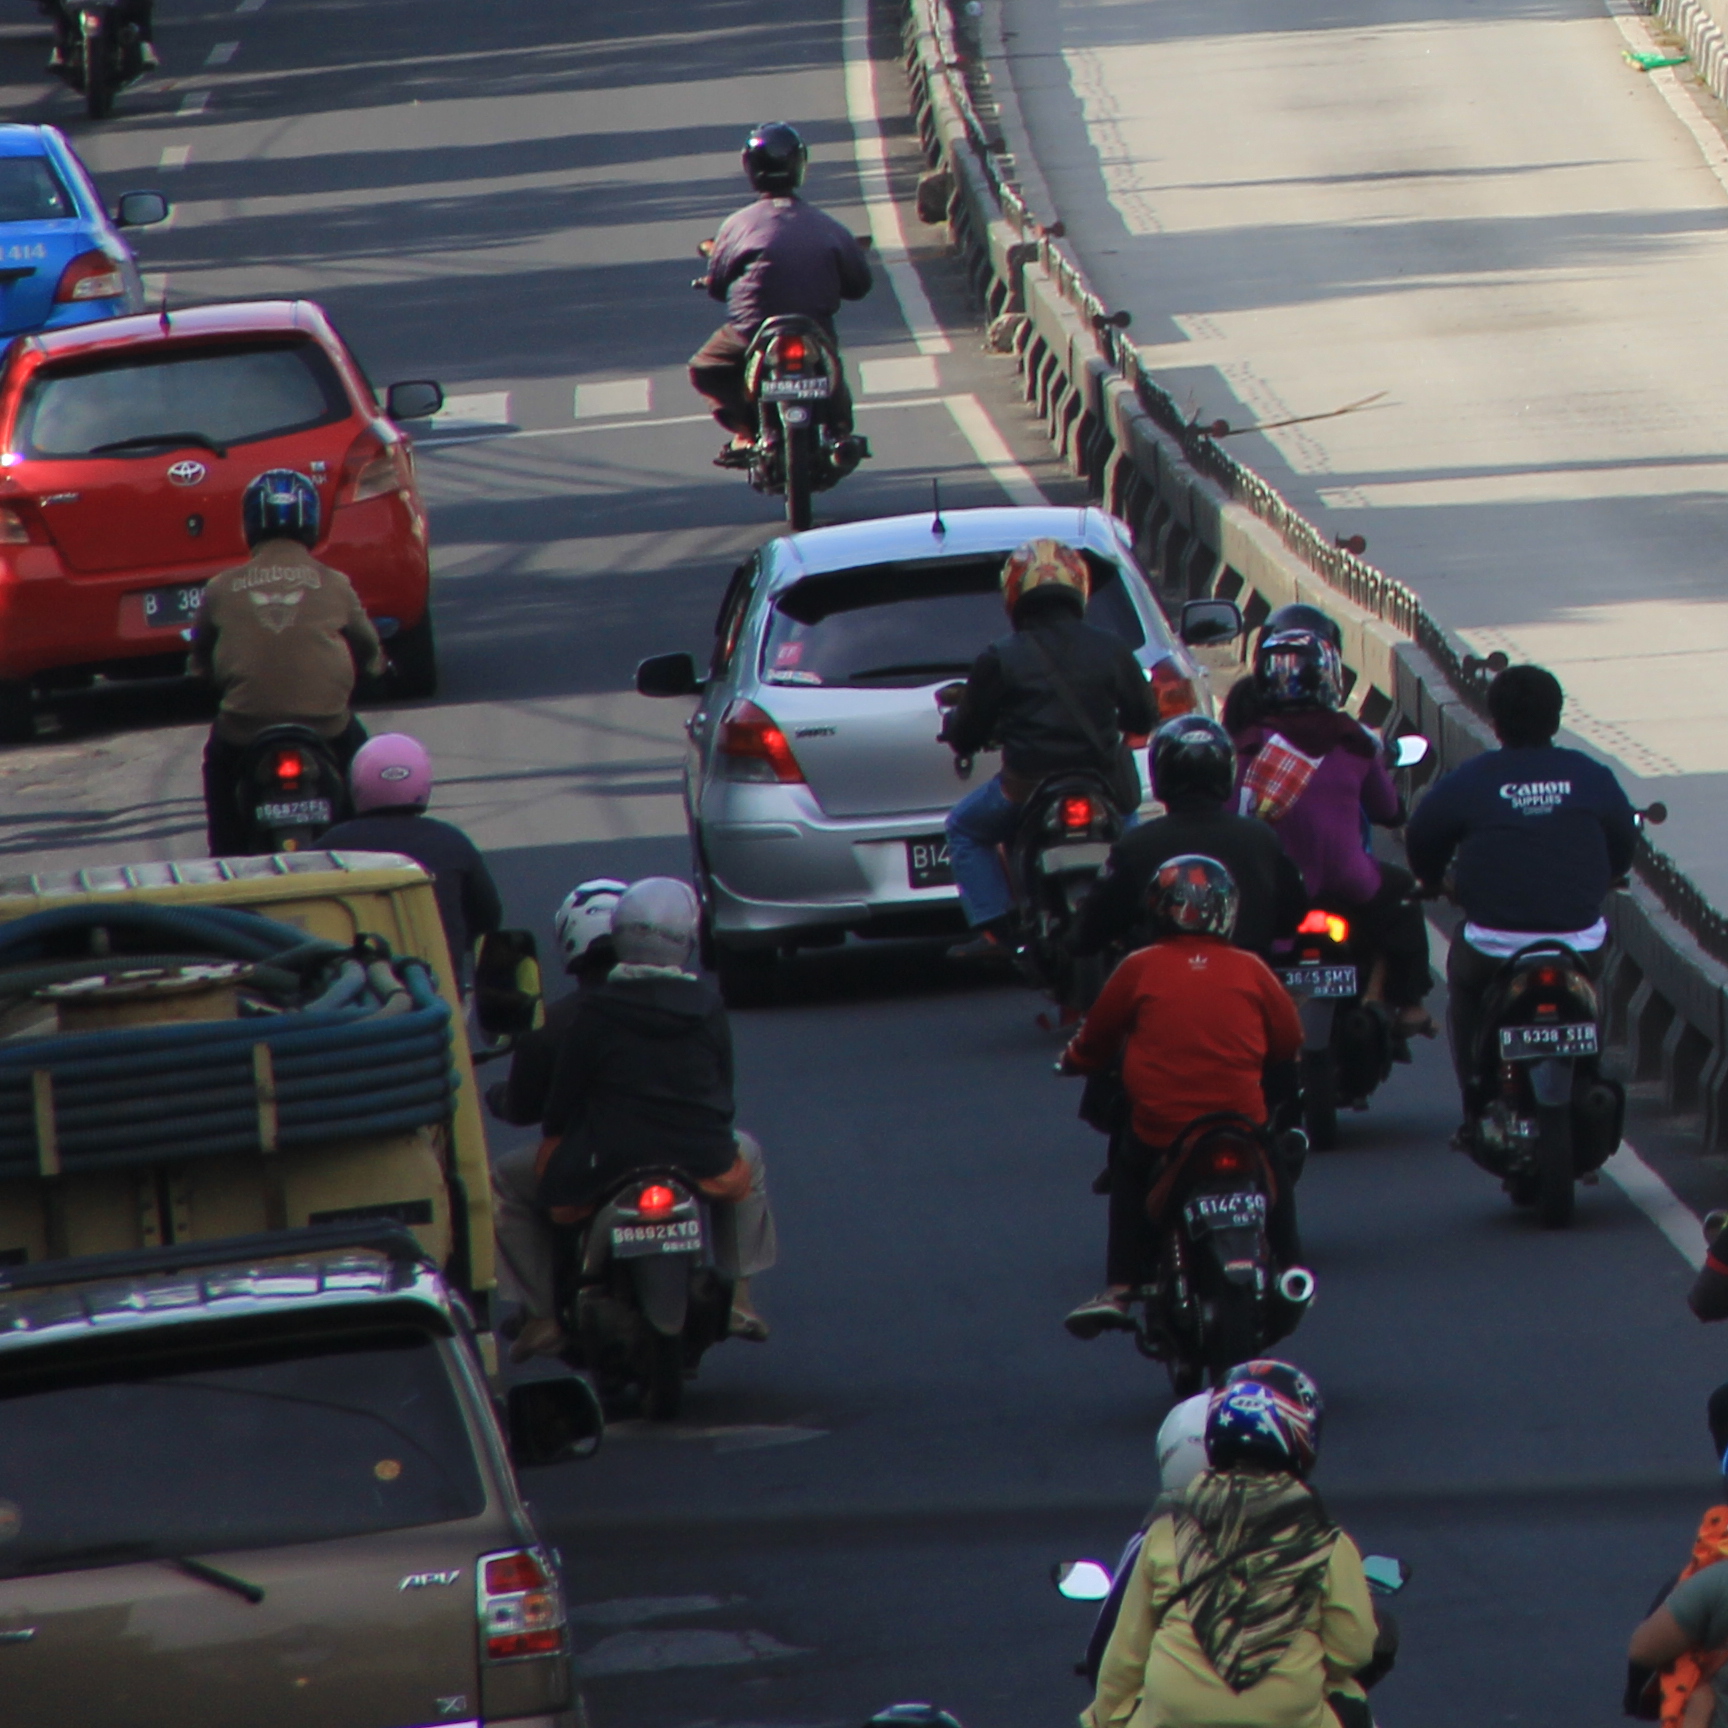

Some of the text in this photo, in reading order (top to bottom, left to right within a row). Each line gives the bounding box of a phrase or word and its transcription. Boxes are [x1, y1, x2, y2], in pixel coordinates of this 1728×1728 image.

[146, 594, 157, 615] B
[1500, 780, 1572, 798] Canon
[1511, 793, 1562, 809] SUPPLIES
[1503, 1030, 1512, 1044] B
[400, 1569, 461, 1591] APV
